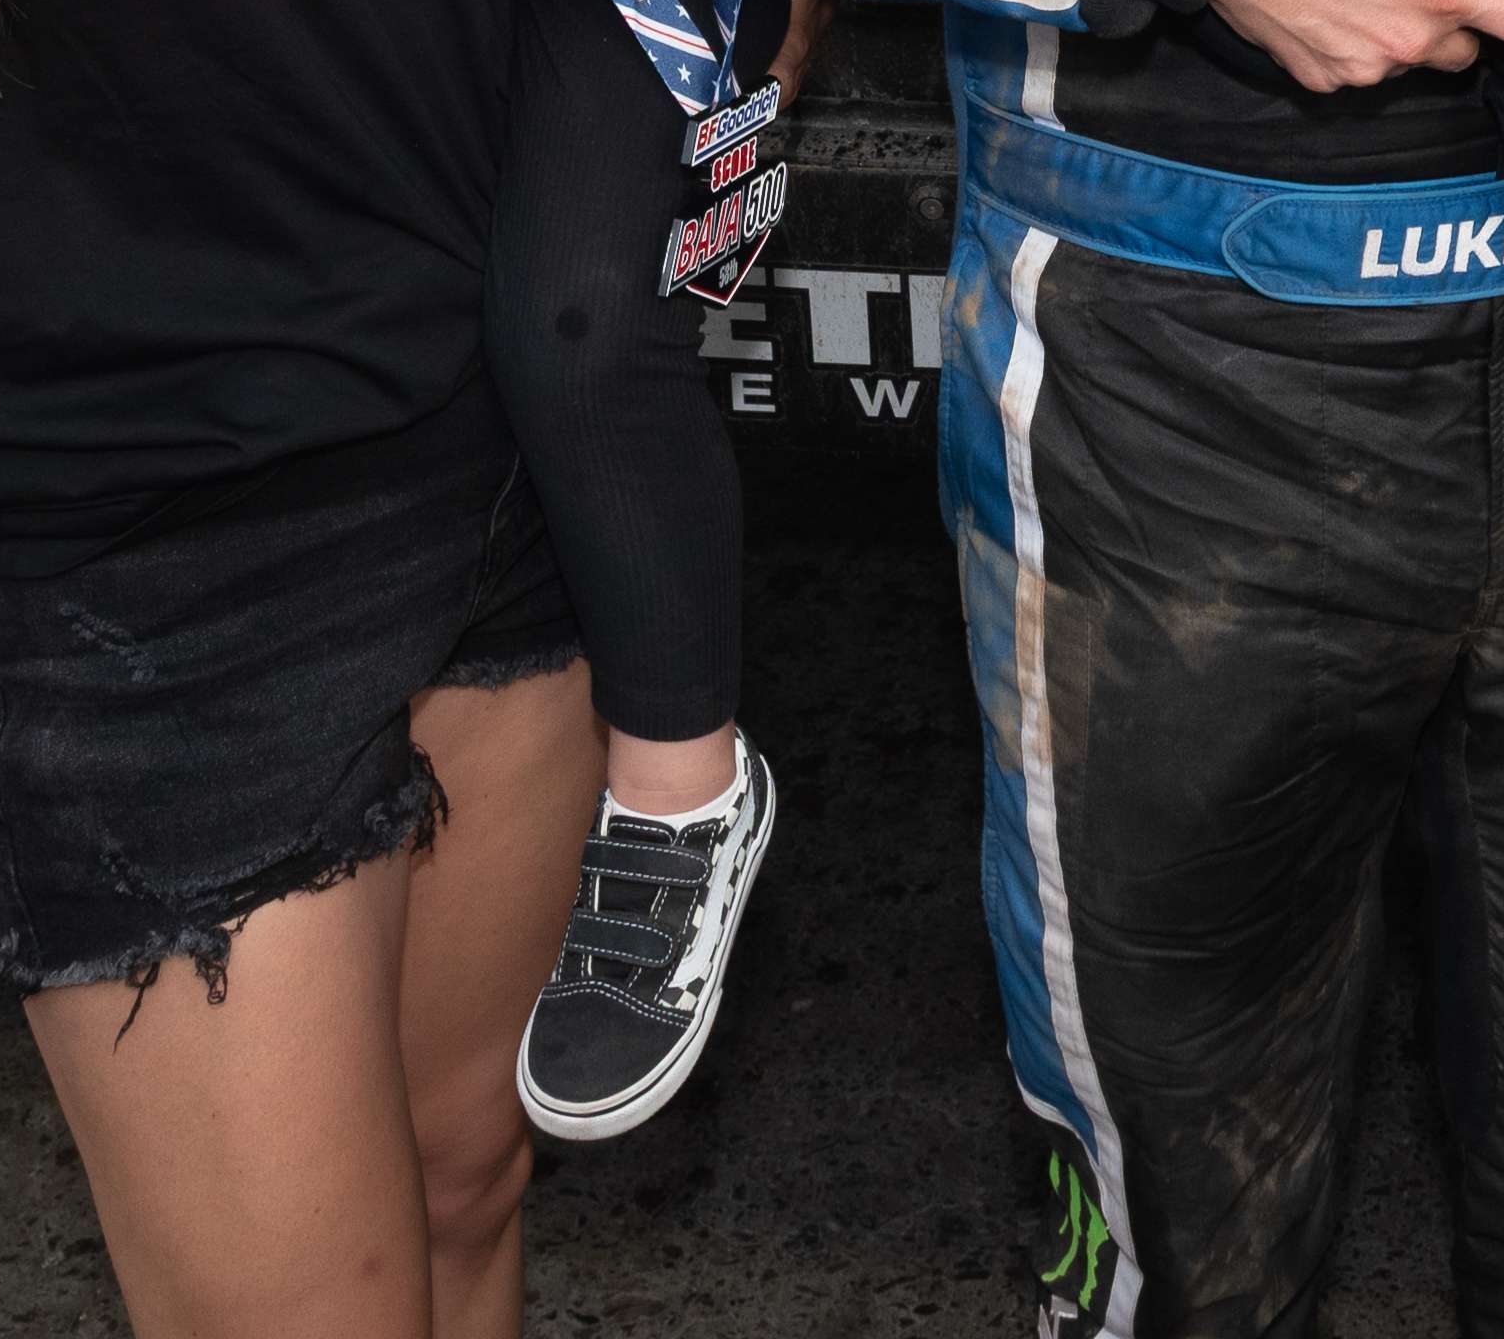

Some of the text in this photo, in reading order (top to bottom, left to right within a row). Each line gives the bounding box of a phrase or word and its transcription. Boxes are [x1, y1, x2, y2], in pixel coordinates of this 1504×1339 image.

[696, 80, 780, 151] BFGoodrich
[711, 136, 757, 193] SCORE
[674, 161, 788, 281] BAJA 500
[718, 257, 739, 289] 58th
